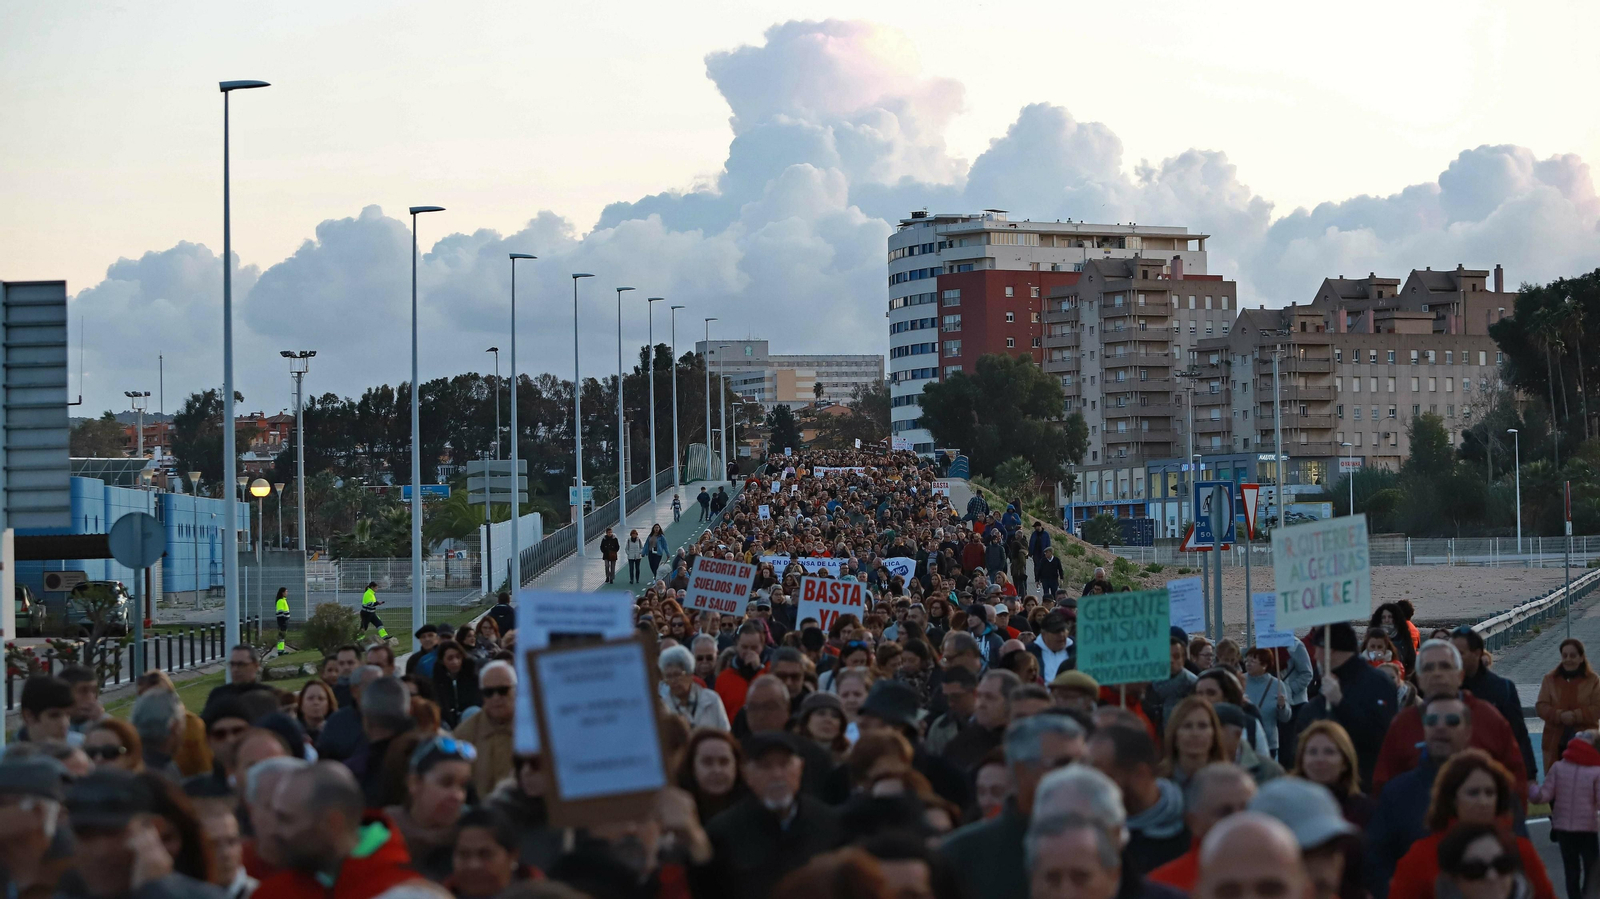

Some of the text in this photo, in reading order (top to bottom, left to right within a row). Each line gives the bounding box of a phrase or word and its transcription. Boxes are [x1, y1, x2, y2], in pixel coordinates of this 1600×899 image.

[699, 559, 752, 579] RECORTA EN
[1289, 549, 1367, 583] ALGECIRAS
[693, 576, 747, 597] SUELDOS NO
[803, 579, 861, 606] BASTA
[694, 595, 737, 613] EN SALUD
[1083, 593, 1168, 621] GERENTE
[1280, 589, 1300, 614] TE
[819, 608, 840, 632] YA
[1082, 619, 1159, 645] DIMISION
[1120, 647, 1130, 661] A
[1134, 645, 1150, 660] LA
